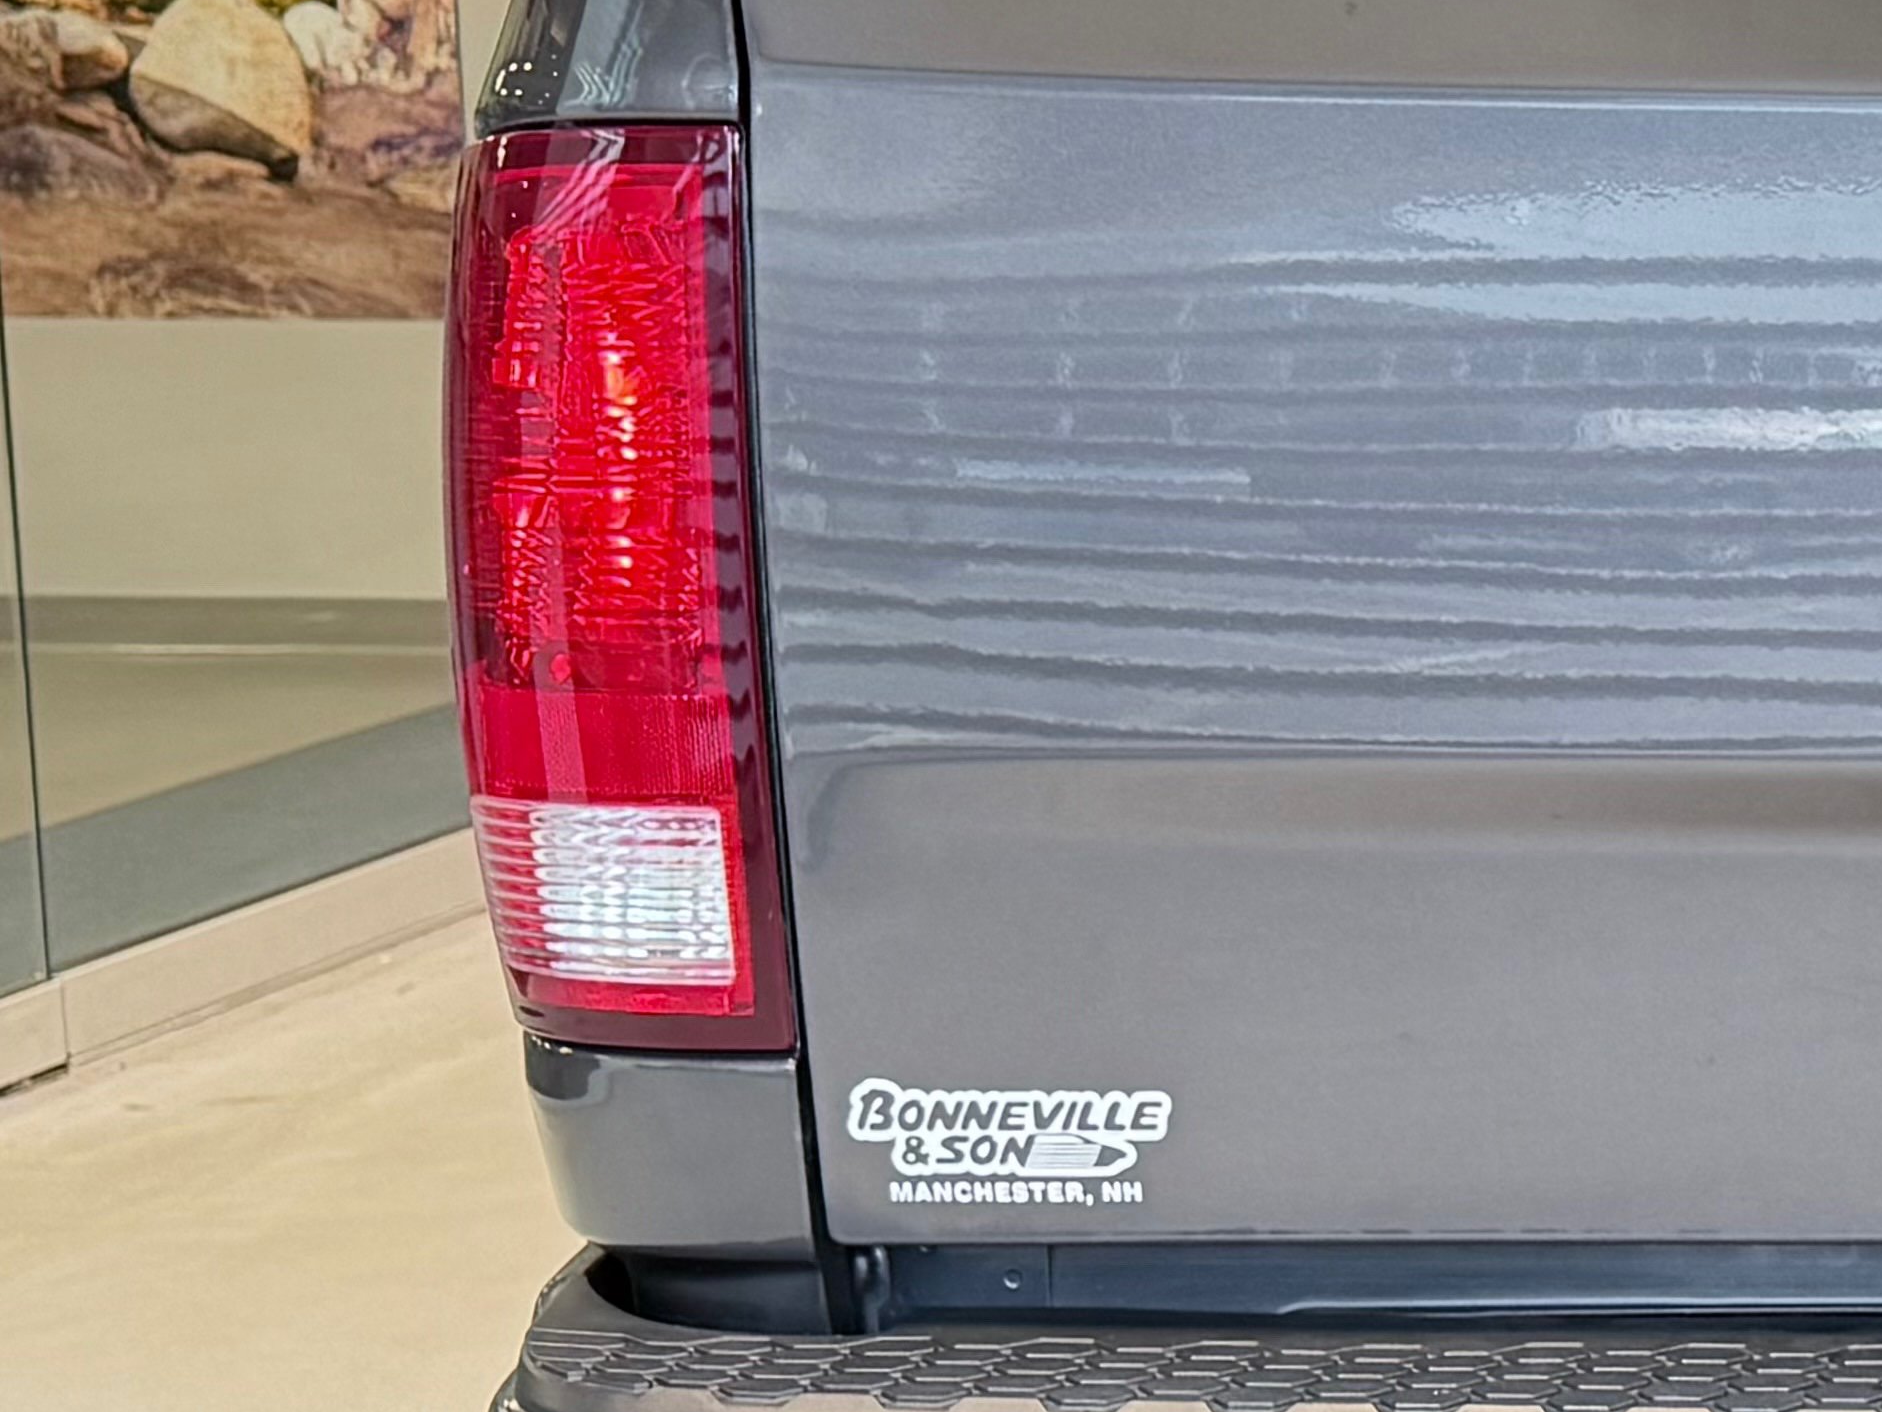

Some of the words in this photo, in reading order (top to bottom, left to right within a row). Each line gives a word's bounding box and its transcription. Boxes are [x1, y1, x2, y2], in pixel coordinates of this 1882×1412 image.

[856, 1088, 1164, 1132] BONNEVILLE
[902, 1136, 930, 1166] &
[935, 1134, 1036, 1169] SON
[889, 1181, 1095, 1207] MANCHESTER,
[1101, 1181, 1144, 1204] NH
